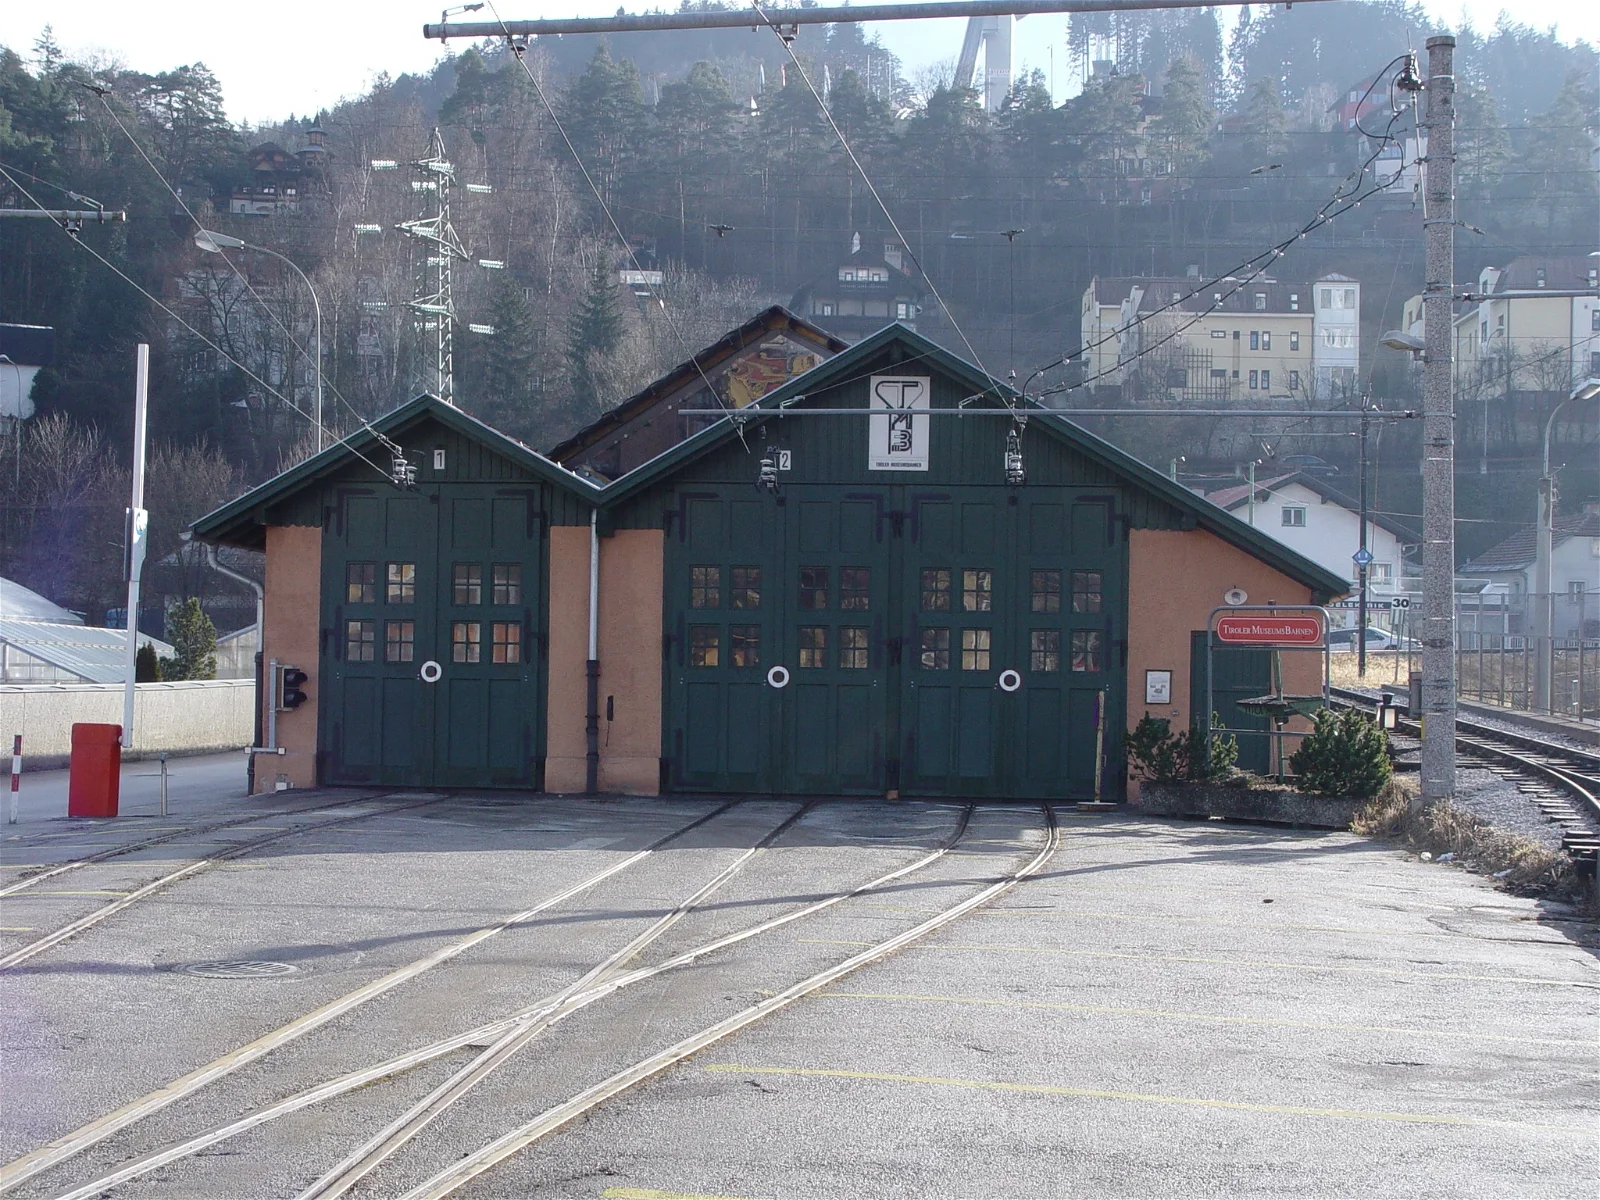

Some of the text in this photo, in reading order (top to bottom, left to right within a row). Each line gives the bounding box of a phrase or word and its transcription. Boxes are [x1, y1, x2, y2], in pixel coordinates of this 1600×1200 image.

[436, 451, 443, 468] 1
[781, 452, 789, 469] 2
[1392, 598, 1409, 608] 30
[1223, 625, 1251, 634] TIROLER
